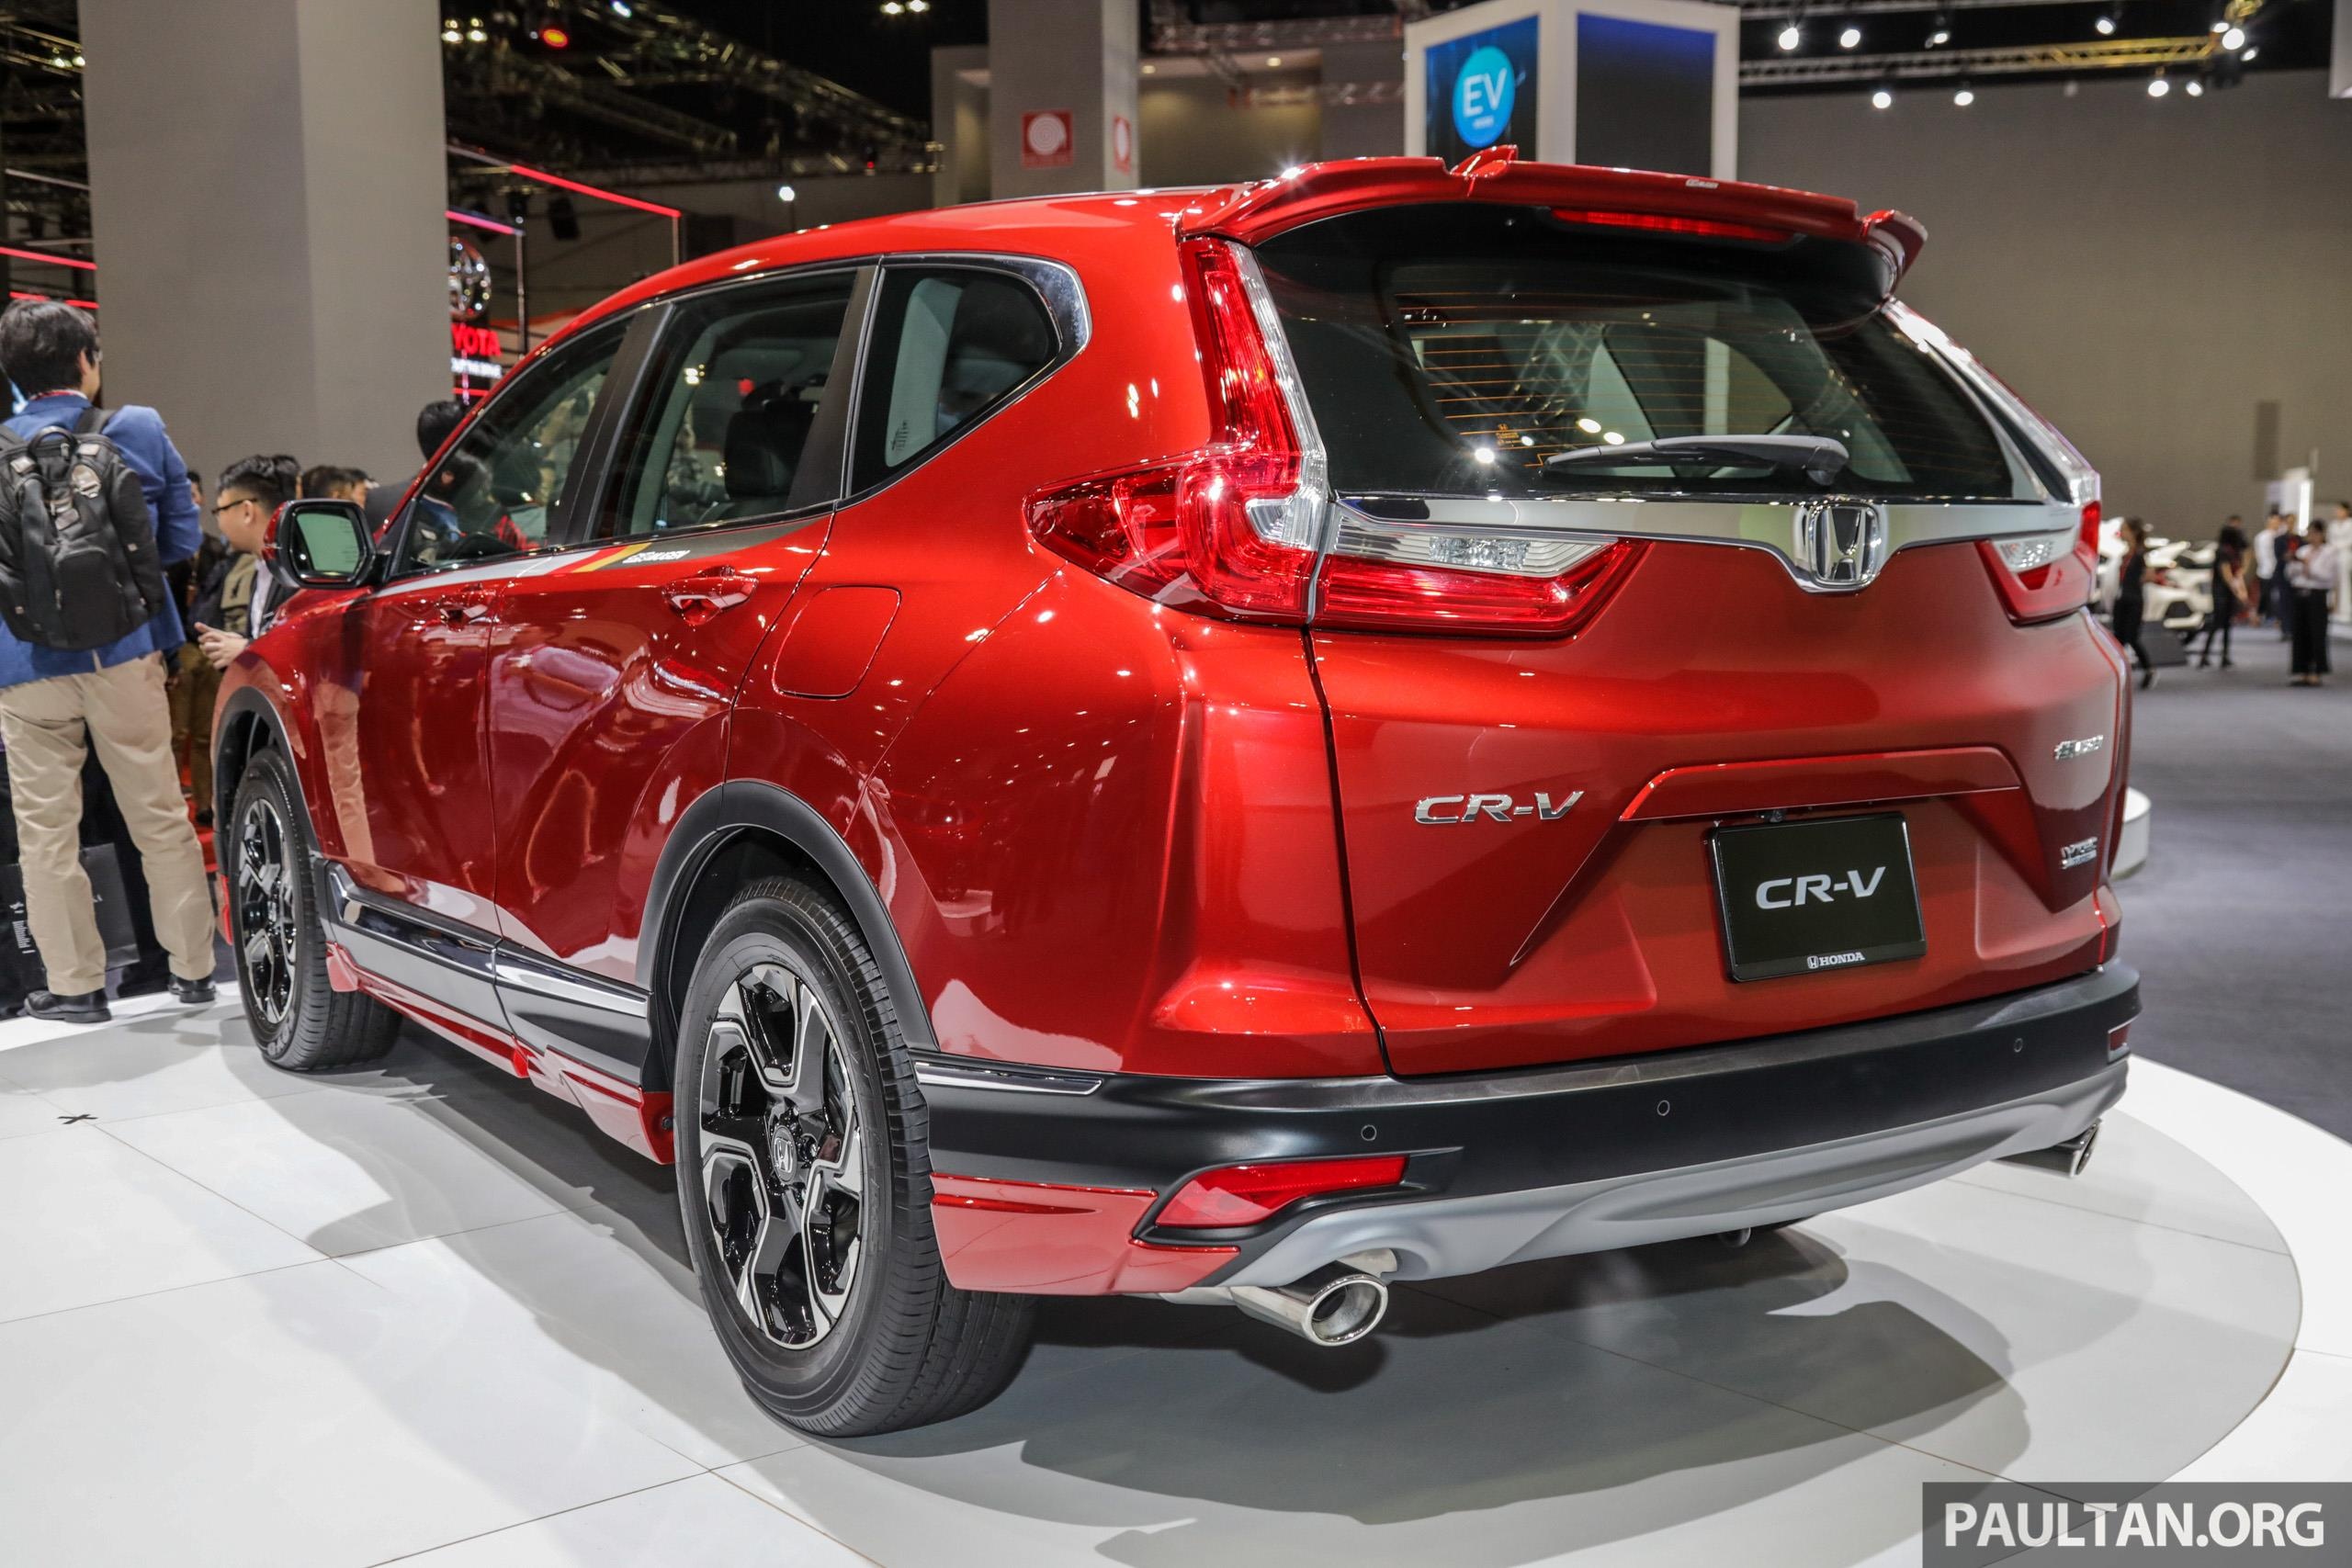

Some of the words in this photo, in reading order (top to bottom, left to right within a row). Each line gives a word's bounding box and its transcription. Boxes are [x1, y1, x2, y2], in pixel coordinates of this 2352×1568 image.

[1463, 67, 1508, 118] EV
[450, 322, 503, 356] YOTA
[1414, 790, 1585, 825] CR-V
[1756, 866, 1886, 909] CR-V
[1818, 951, 1866, 967] HONDA
